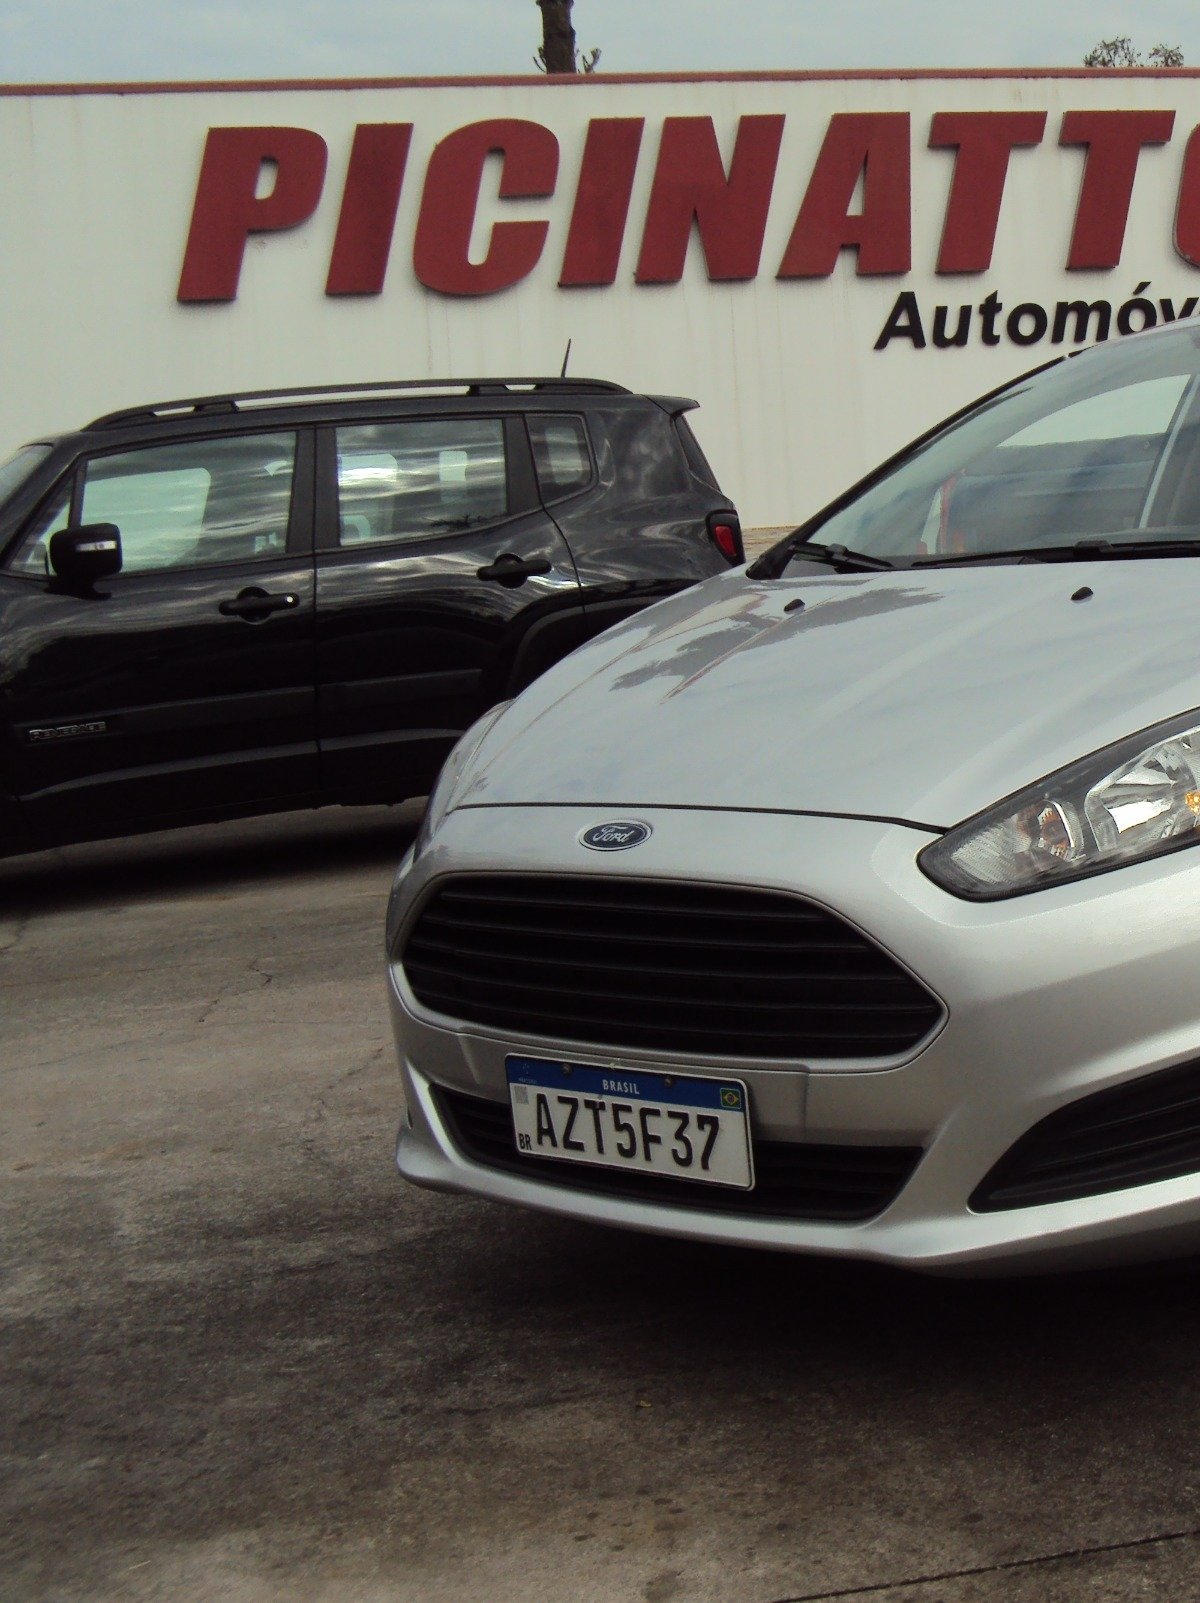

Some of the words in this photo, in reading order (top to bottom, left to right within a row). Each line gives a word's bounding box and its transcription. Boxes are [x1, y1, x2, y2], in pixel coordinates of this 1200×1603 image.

[592, 825, 636, 843] Ford
[602, 1078, 640, 1095] BRASIL
[536, 1092, 720, 1171] AZT5F37
[518, 1132, 533, 1151] BR
